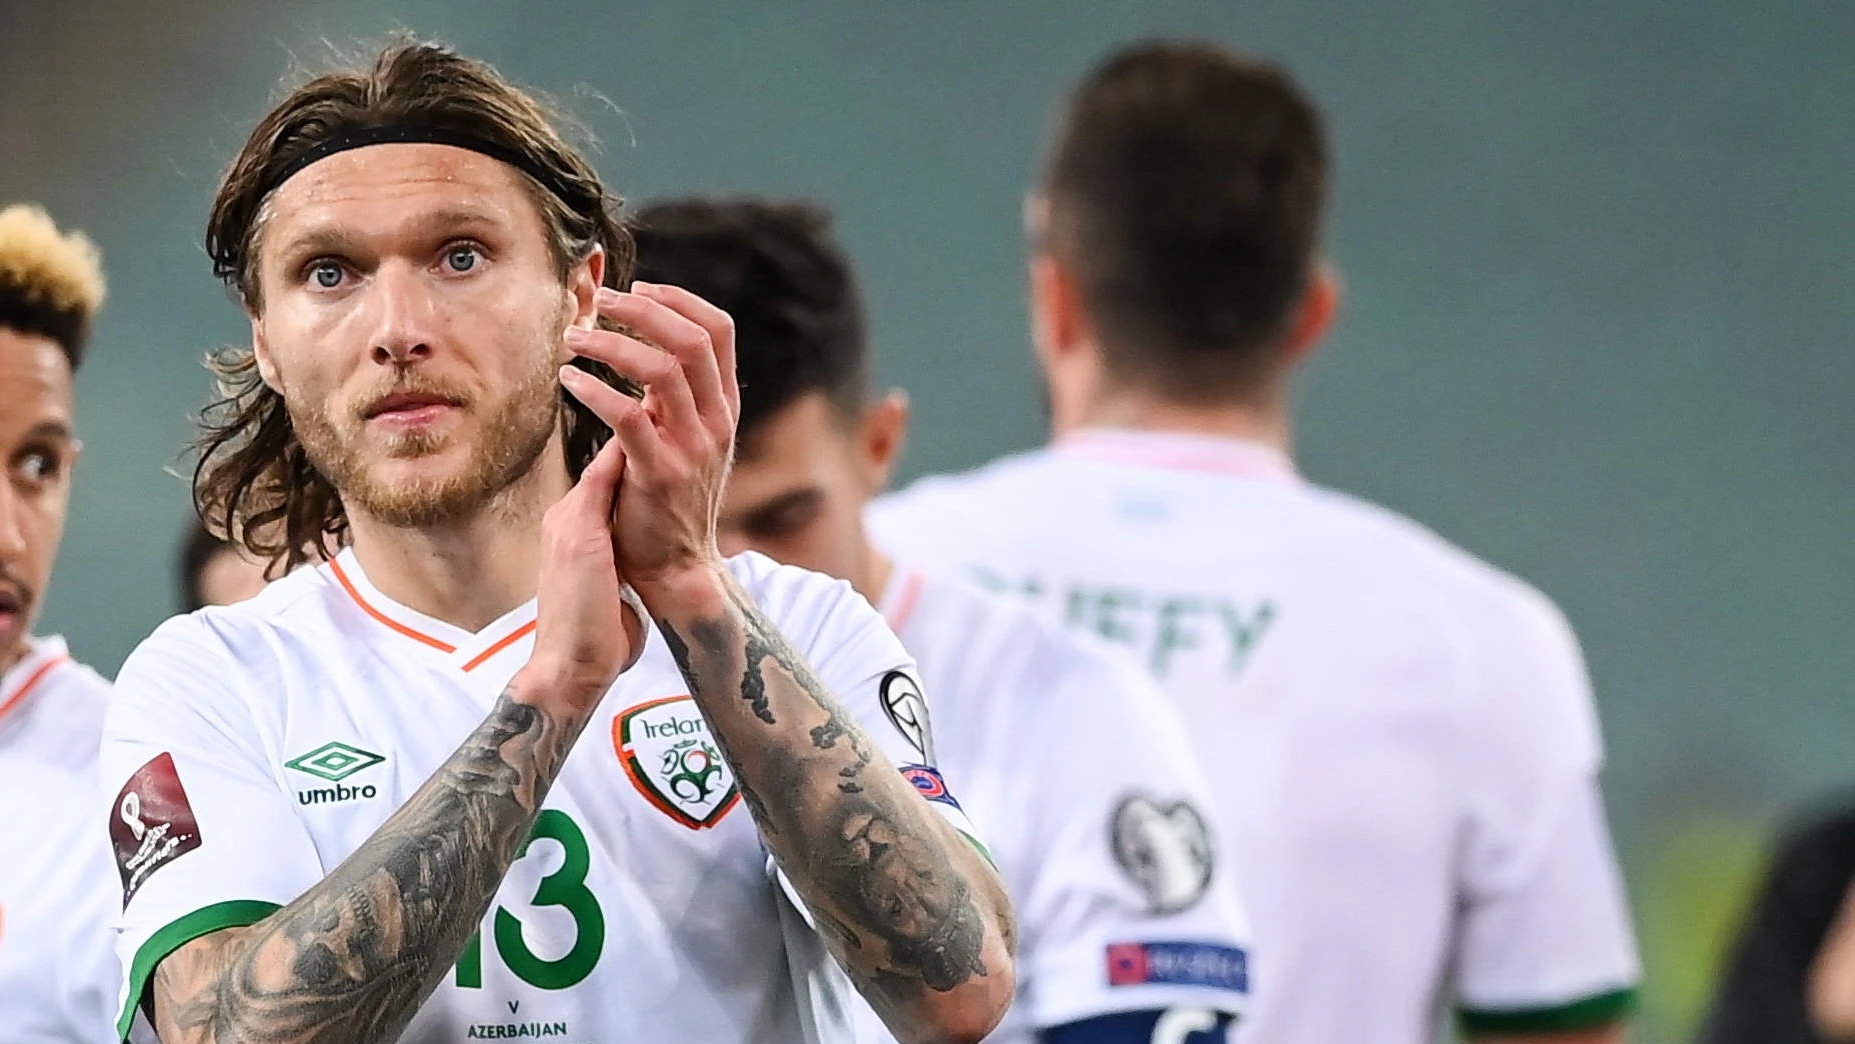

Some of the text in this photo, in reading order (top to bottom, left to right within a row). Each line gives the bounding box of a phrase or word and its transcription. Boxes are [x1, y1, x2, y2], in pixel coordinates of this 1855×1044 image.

[298, 783, 377, 806] umbro
[507, 1000, 520, 1015] V
[467, 1022, 568, 1040] AZERBAIJAN
